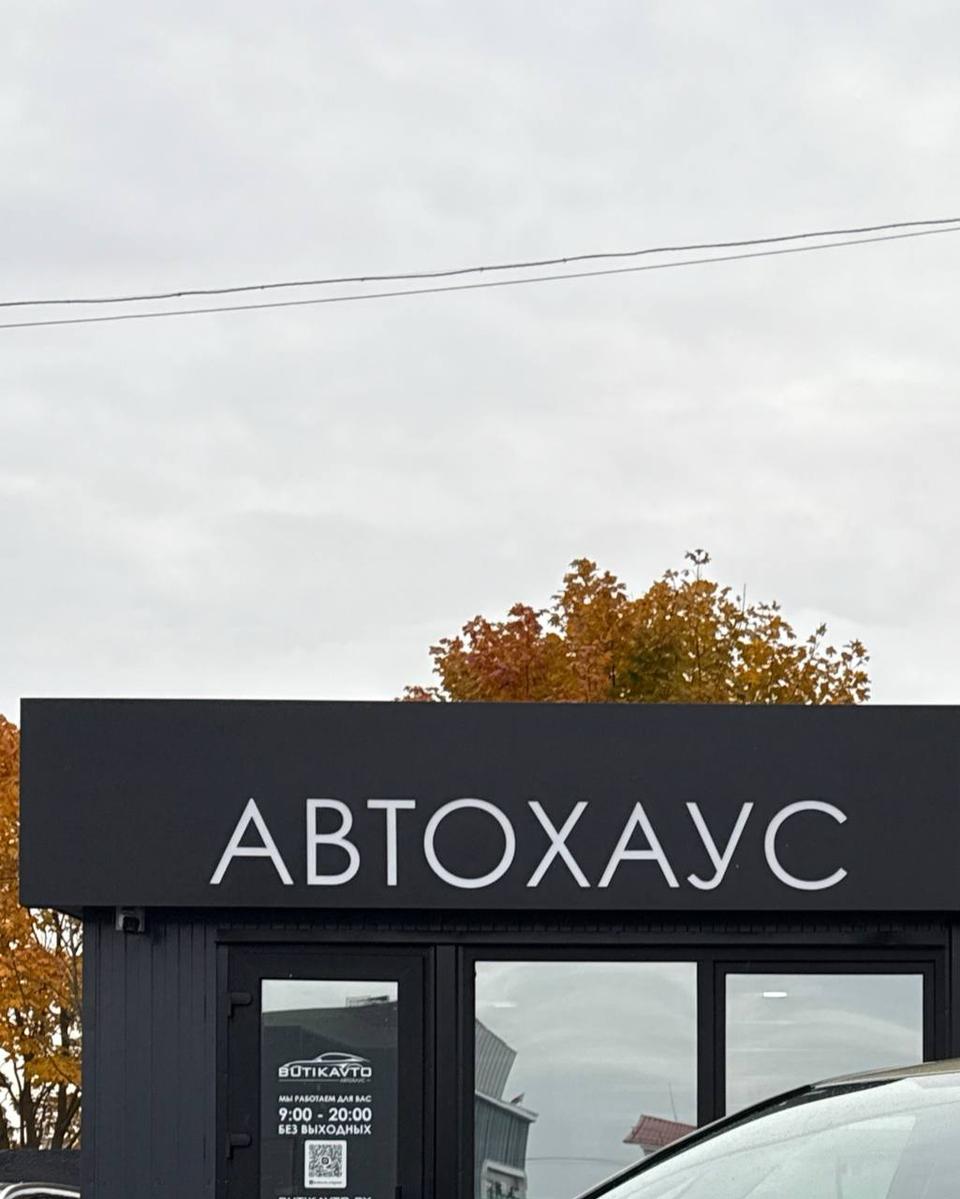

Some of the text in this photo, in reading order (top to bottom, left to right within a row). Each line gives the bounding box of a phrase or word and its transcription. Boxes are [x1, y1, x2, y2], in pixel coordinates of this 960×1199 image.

[209, 797, 848, 890] АВТОХАУС
[278, 1066, 372, 1077] BUTIKAVTO
[294, 1095, 335, 1103] РАБОТАЕМ
[337, 1095, 354, 1103] ДЛЯ
[278, 1107, 312, 1122] 9:00
[328, 1107, 372, 1122] 20:00
[278, 1124, 372, 1135] БЕЗ ВЫХОДНЫХ
